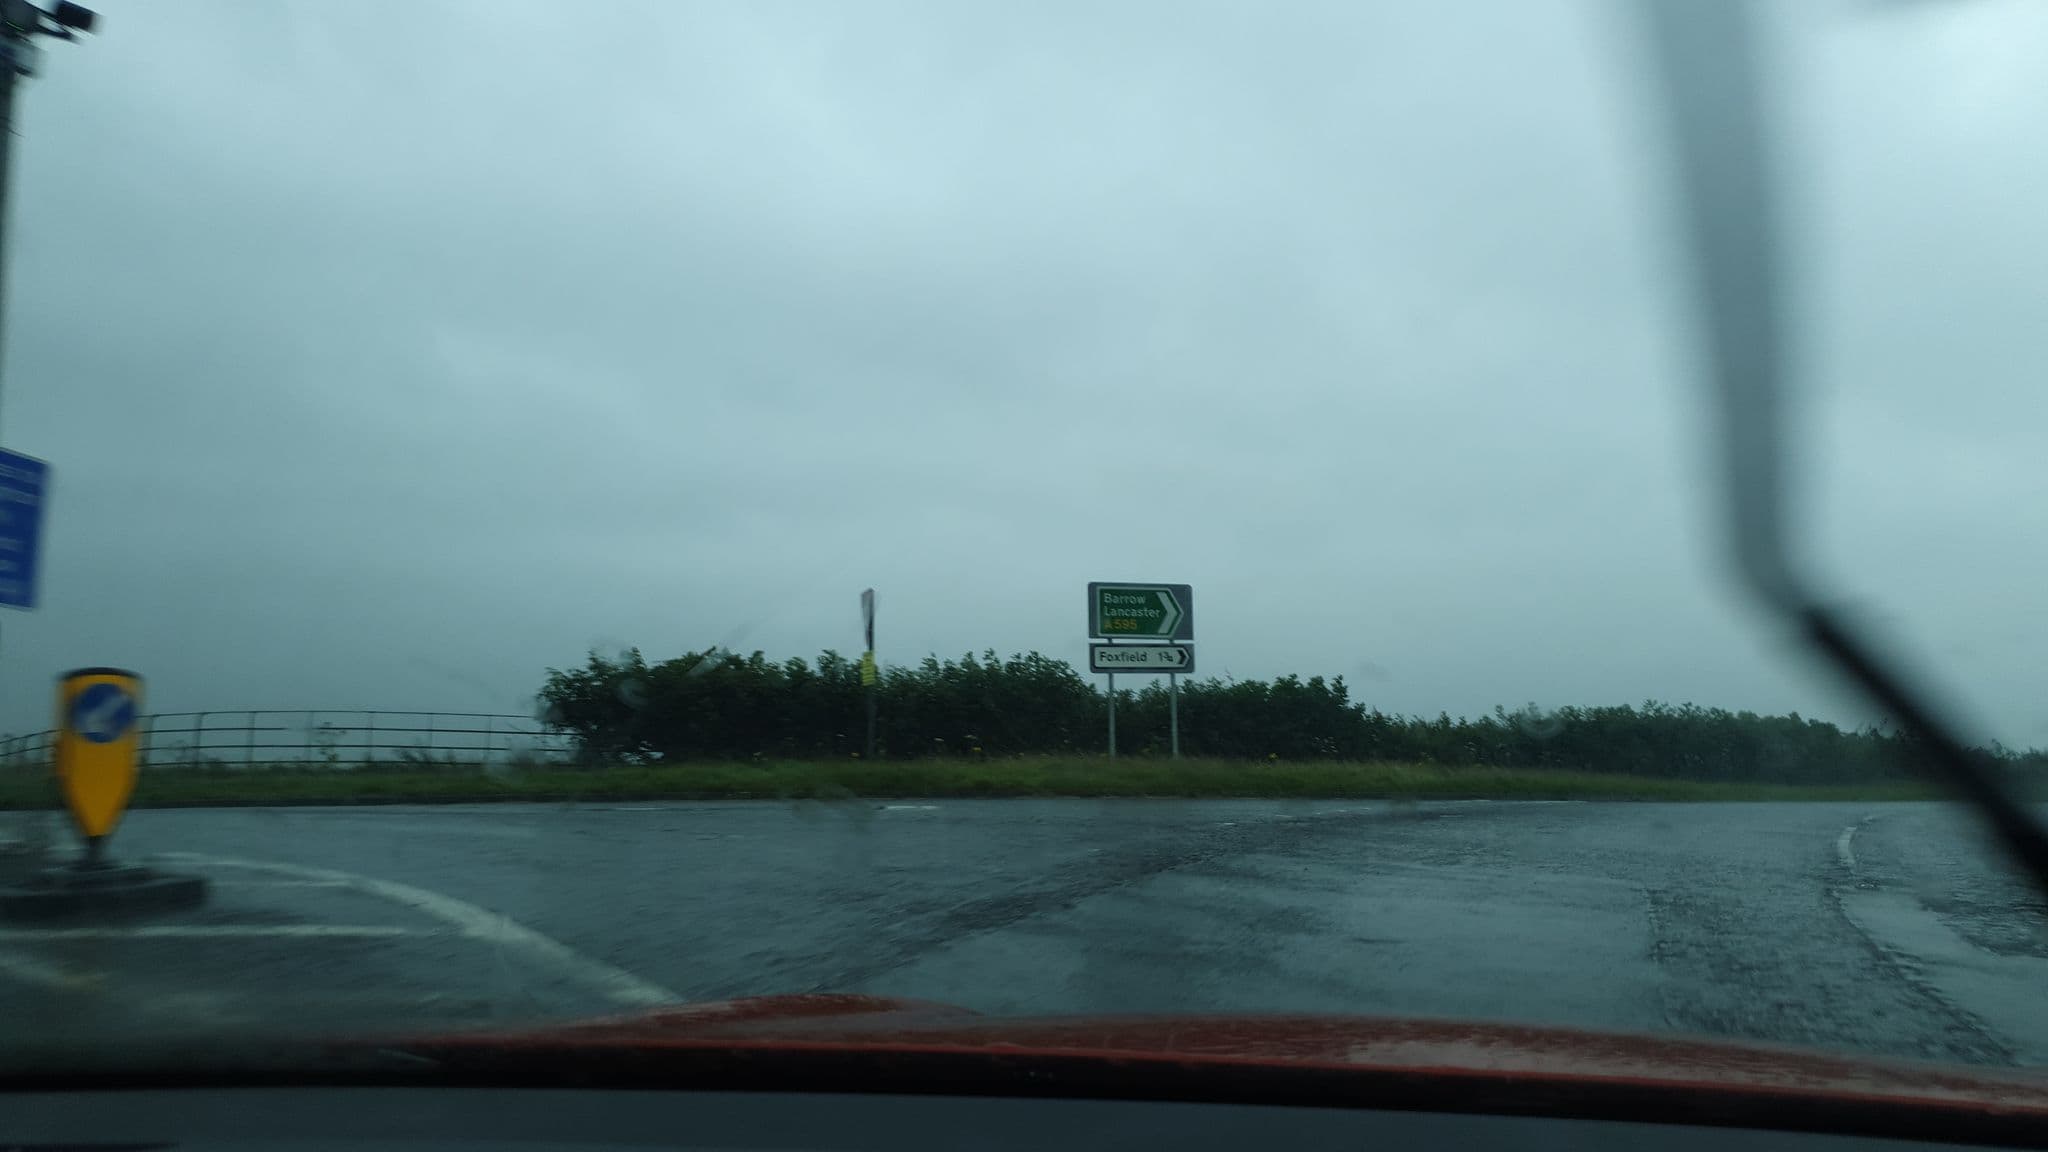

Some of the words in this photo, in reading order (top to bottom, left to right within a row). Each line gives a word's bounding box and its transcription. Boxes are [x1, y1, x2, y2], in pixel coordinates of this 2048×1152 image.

[1104, 593, 1145, 604] Barrow
[1104, 606, 1160, 618] Lancaster
[1100, 651, 1147, 662] Foxfield
